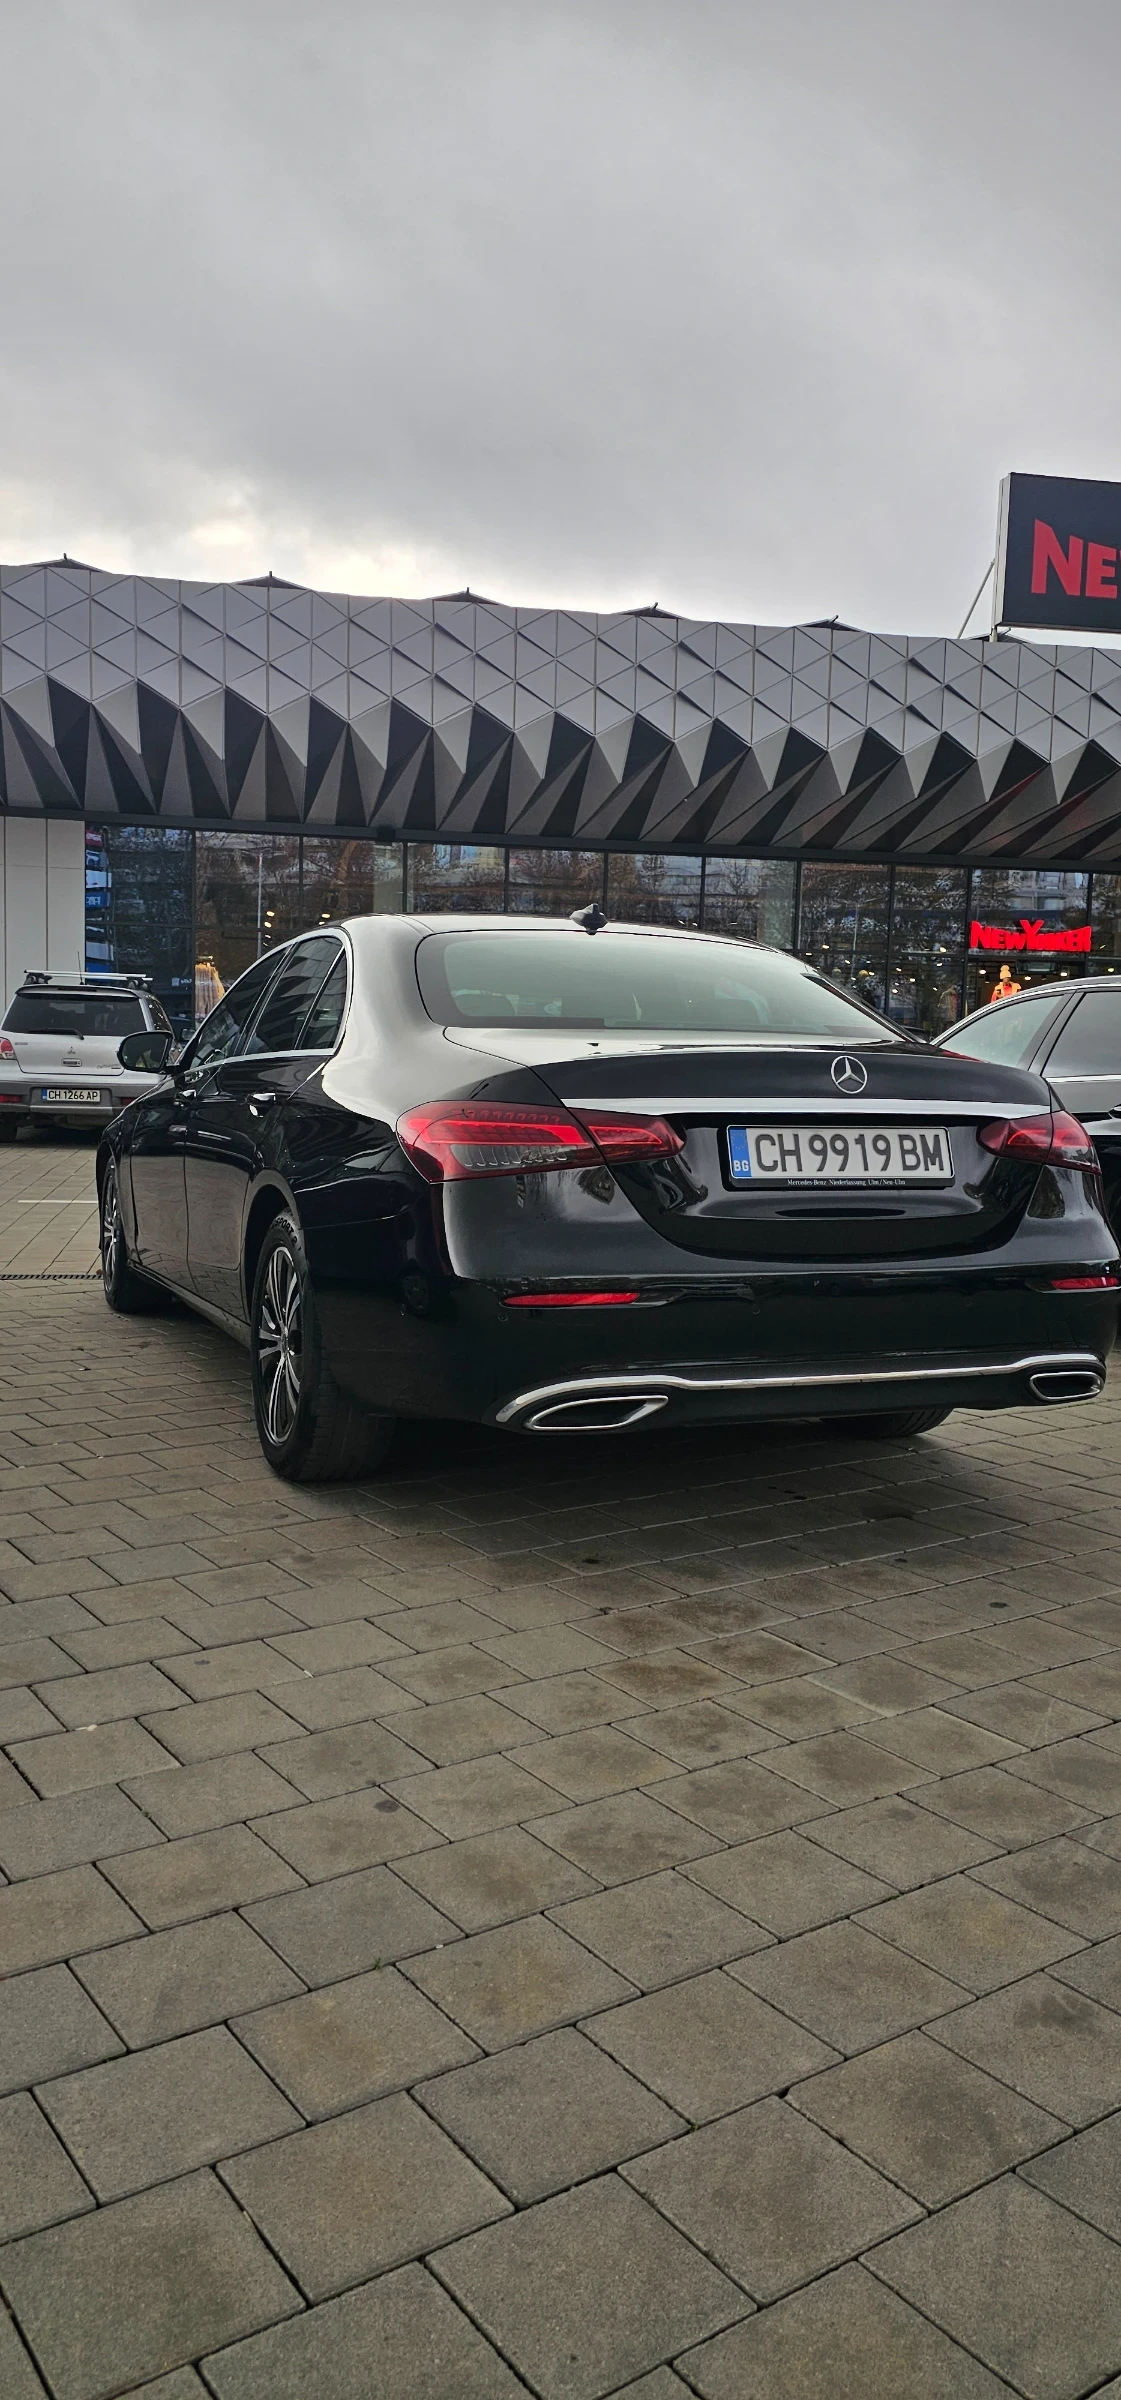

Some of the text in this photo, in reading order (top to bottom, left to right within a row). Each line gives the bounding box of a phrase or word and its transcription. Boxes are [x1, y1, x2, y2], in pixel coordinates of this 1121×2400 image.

[1031, 518, 1121, 599] NE
[970, 919, 1092, 952] NEWYKER
[48, 1090, 61, 1100] CH
[63, 1090, 85, 1100] 1266
[86, 1091, 98, 1101] AP
[755, 1133, 944, 1172] CH 9919 BM
[733, 1160, 749, 1172] BG
[829, 1179, 867, 1187] Niederlassung
